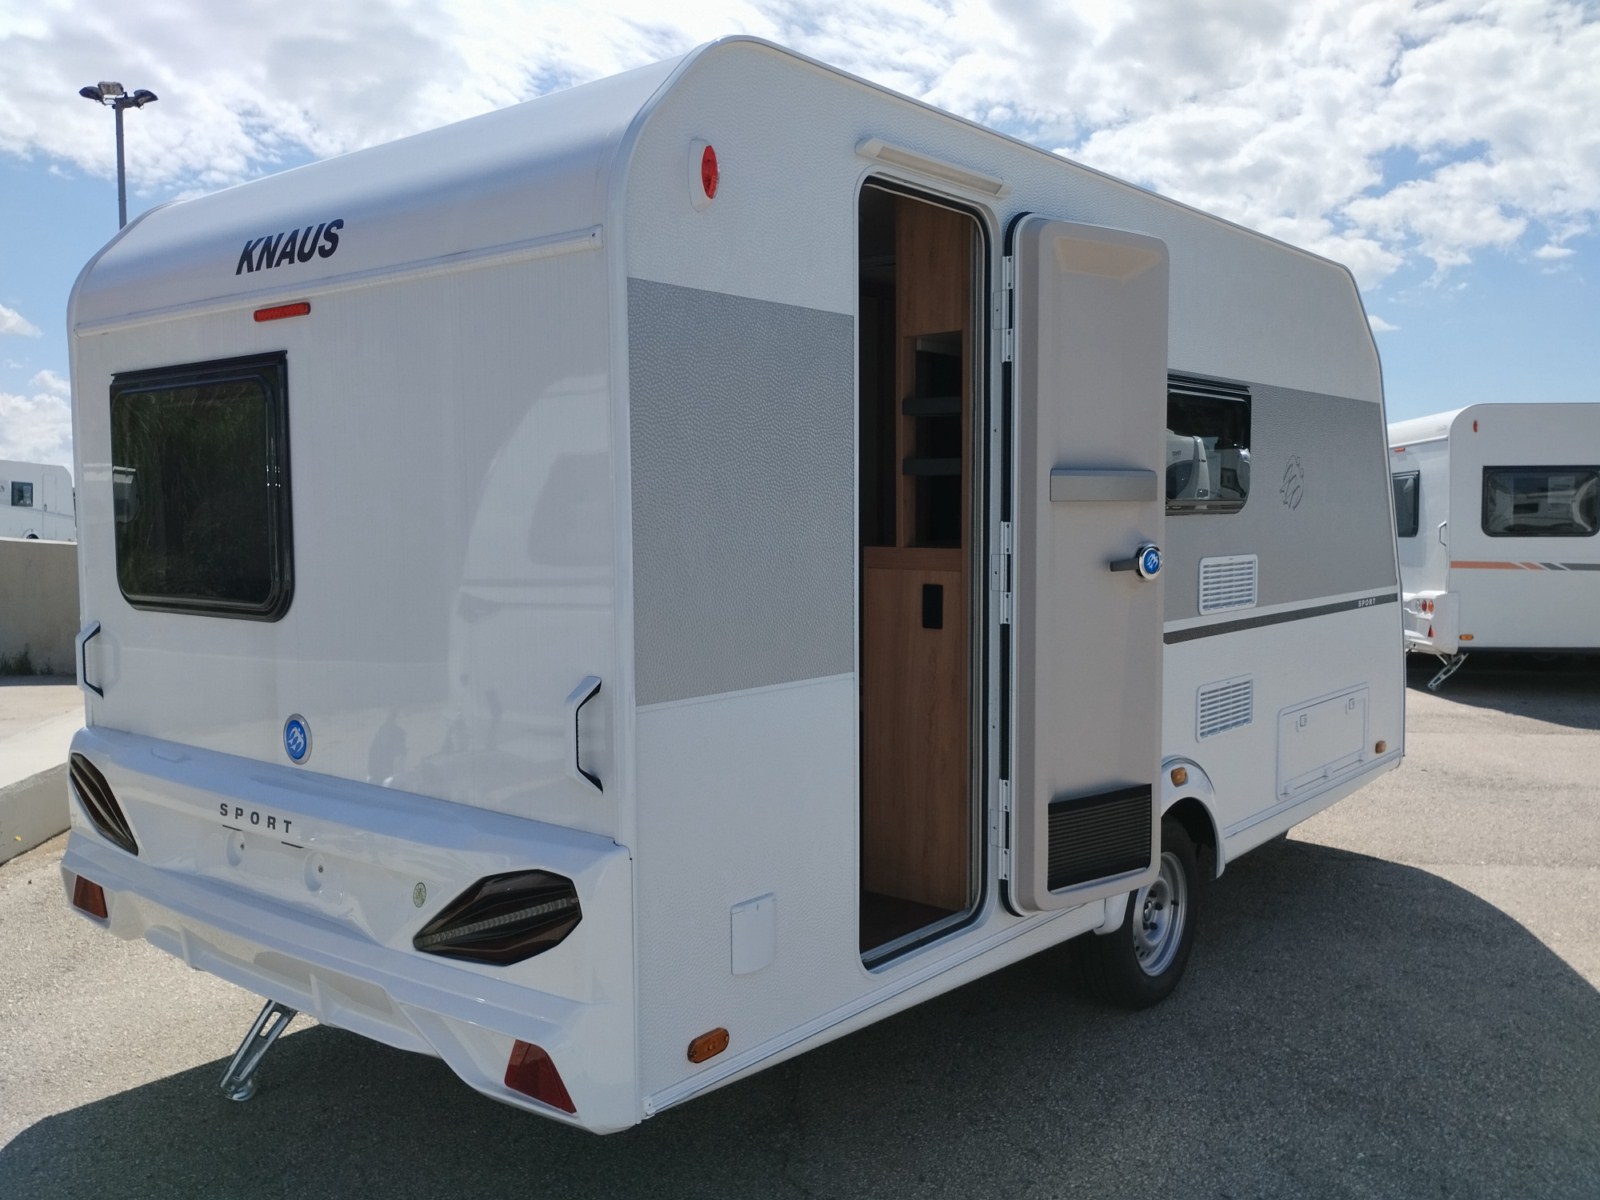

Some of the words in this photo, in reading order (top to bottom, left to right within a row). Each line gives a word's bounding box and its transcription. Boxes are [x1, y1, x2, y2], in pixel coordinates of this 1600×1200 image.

[235, 218, 344, 276] KNAUS
[1358, 597, 1376, 608] SPORT
[219, 803, 292, 834] SPORT
